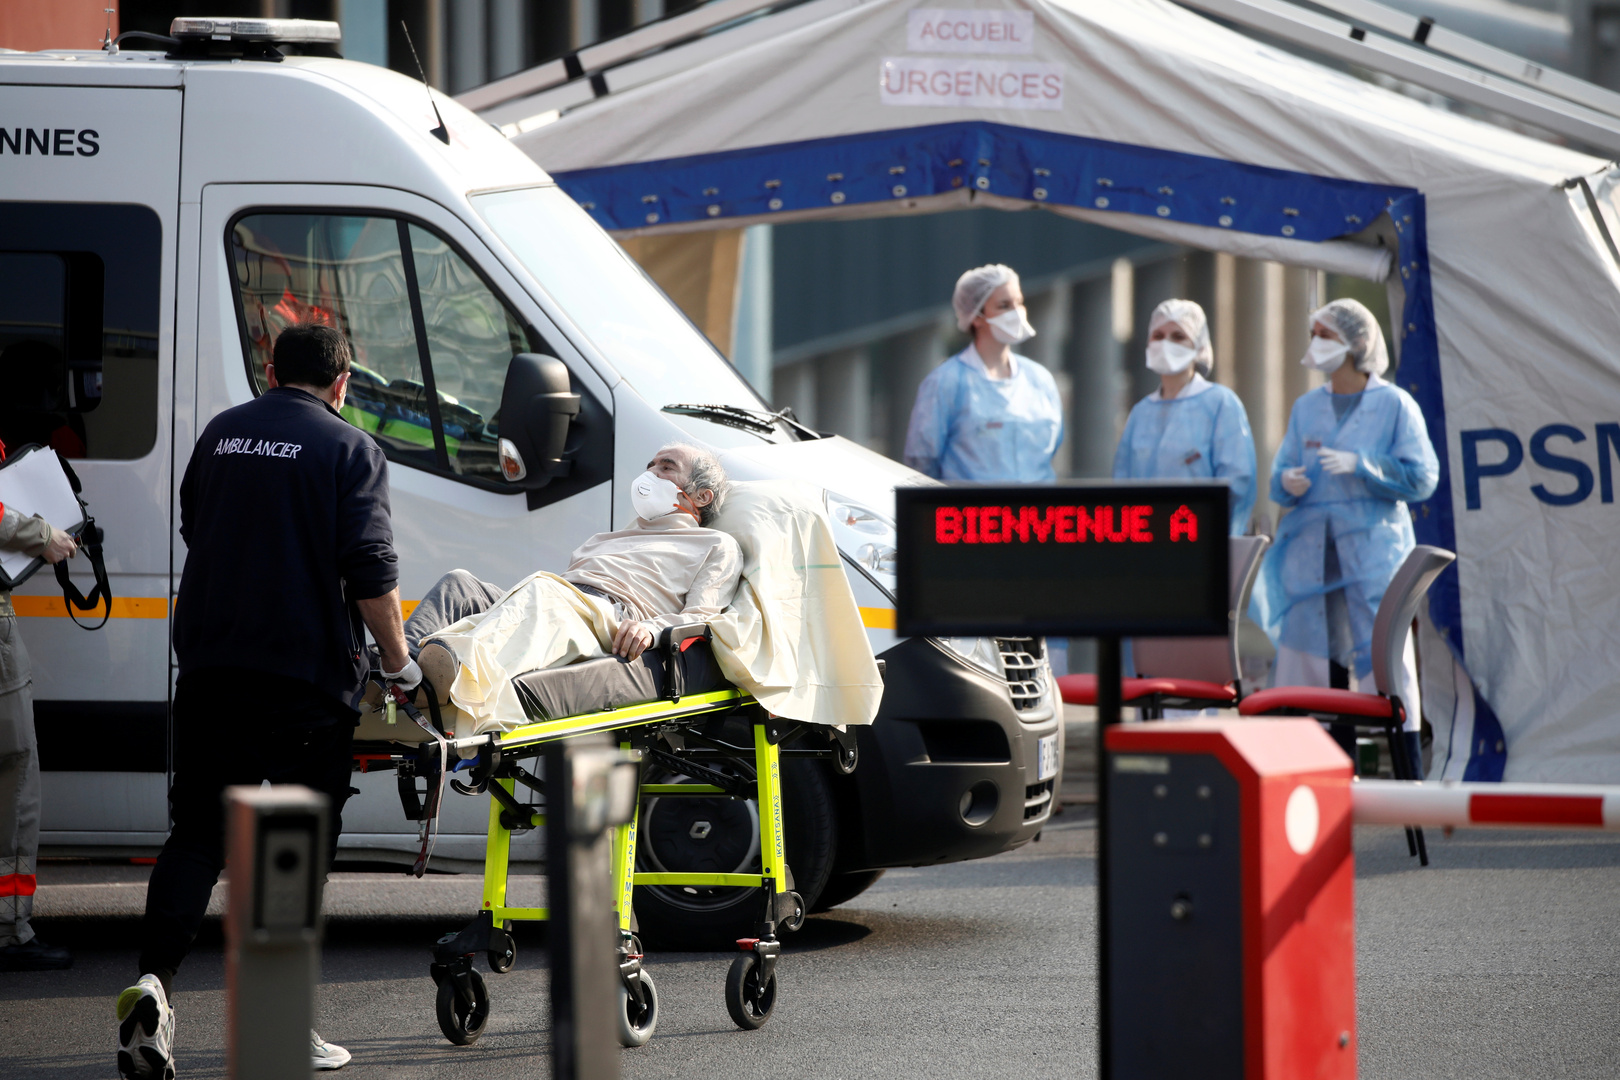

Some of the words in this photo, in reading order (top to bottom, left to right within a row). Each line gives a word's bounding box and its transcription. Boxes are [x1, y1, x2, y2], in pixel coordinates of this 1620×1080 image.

[920, 21, 1022, 42] ACCUEIL
[884, 70, 1062, 99] URGENCES
[0, 128, 100, 157] NNES
[213, 438, 302, 459] AMBULANCIER
[935, 505, 1154, 544] BIENVENUE
[1169, 504, 1198, 542] A
[773, 800, 783, 856] KARTSANA
